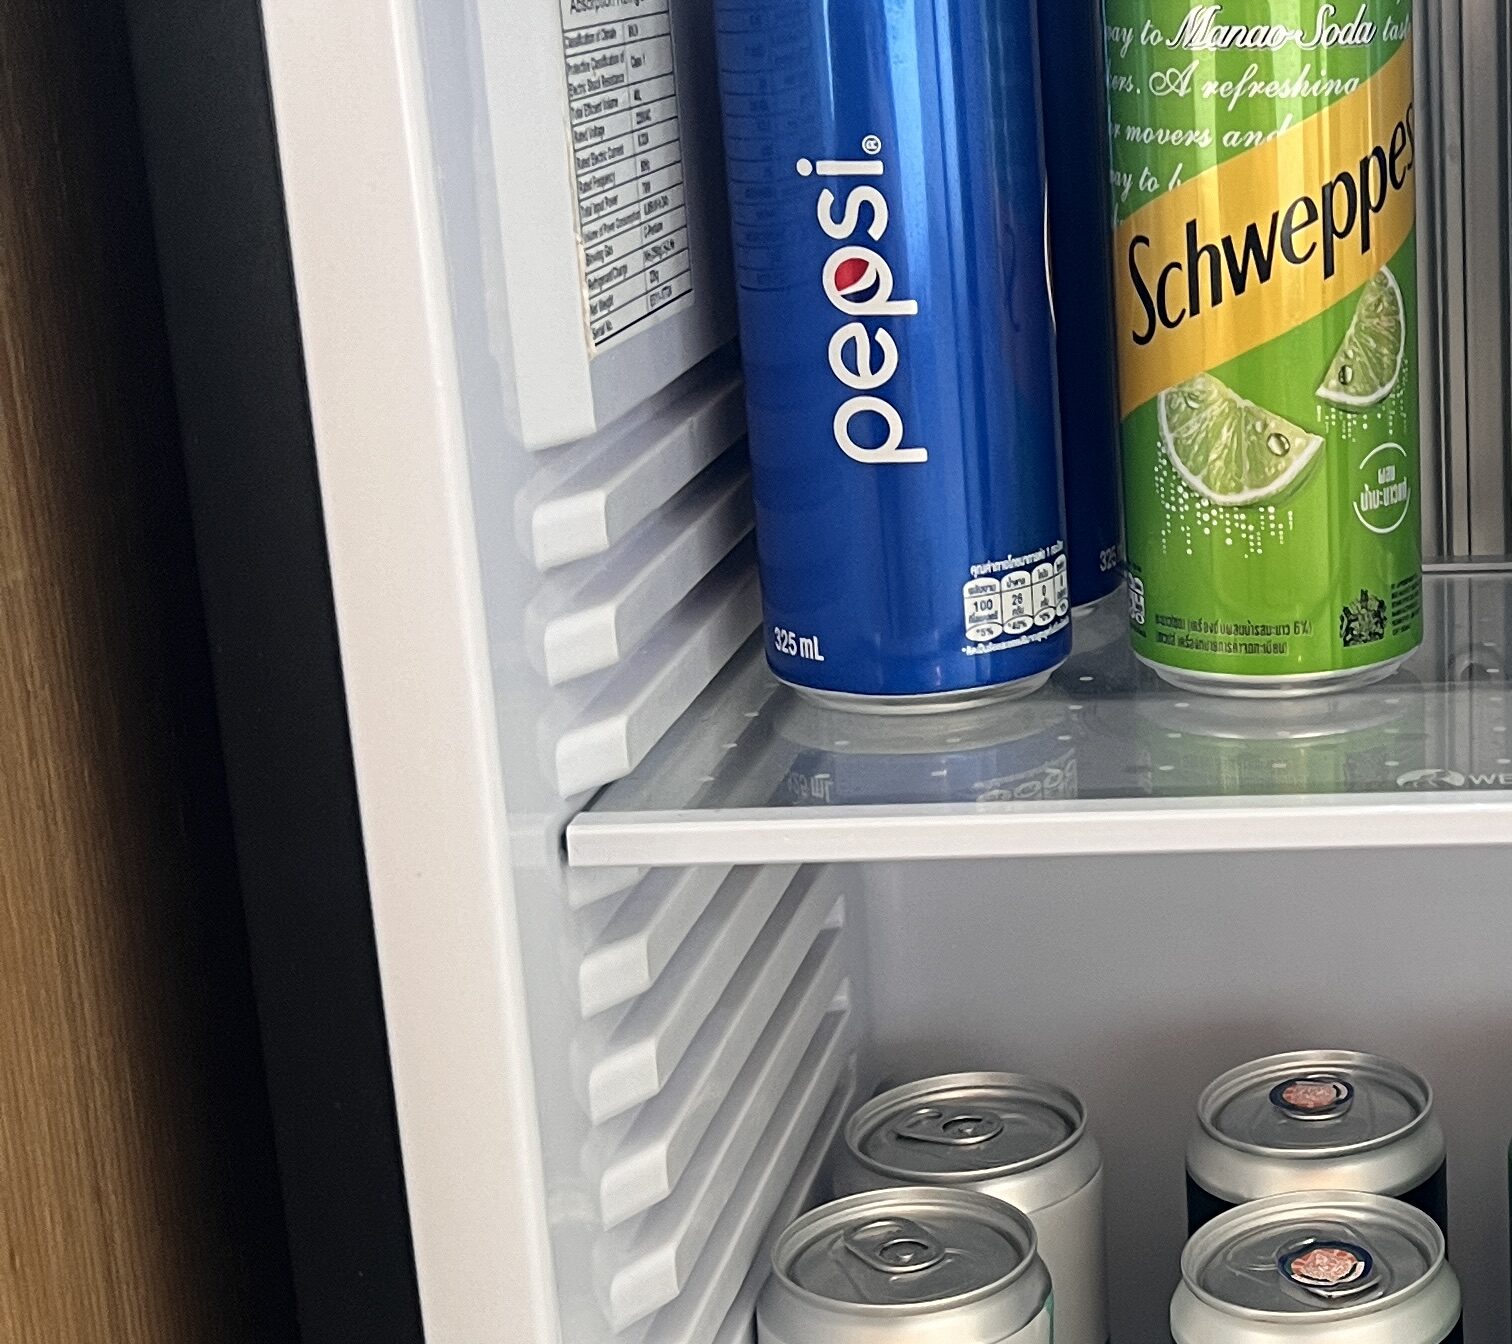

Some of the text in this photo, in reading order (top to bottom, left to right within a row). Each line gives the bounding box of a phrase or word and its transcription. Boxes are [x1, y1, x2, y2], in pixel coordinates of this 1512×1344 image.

[1141, 20, 1163, 46] to
[1299, 3, 1377, 49] Soda
[1149, 59, 1200, 97] A
[1126, 123, 1212, 149] movers
[1138, 166, 1158, 192] to
[796, 157, 928, 465] pepsi
[974, 599, 994, 612] 100
[774, 626, 825, 662] 325 mL
